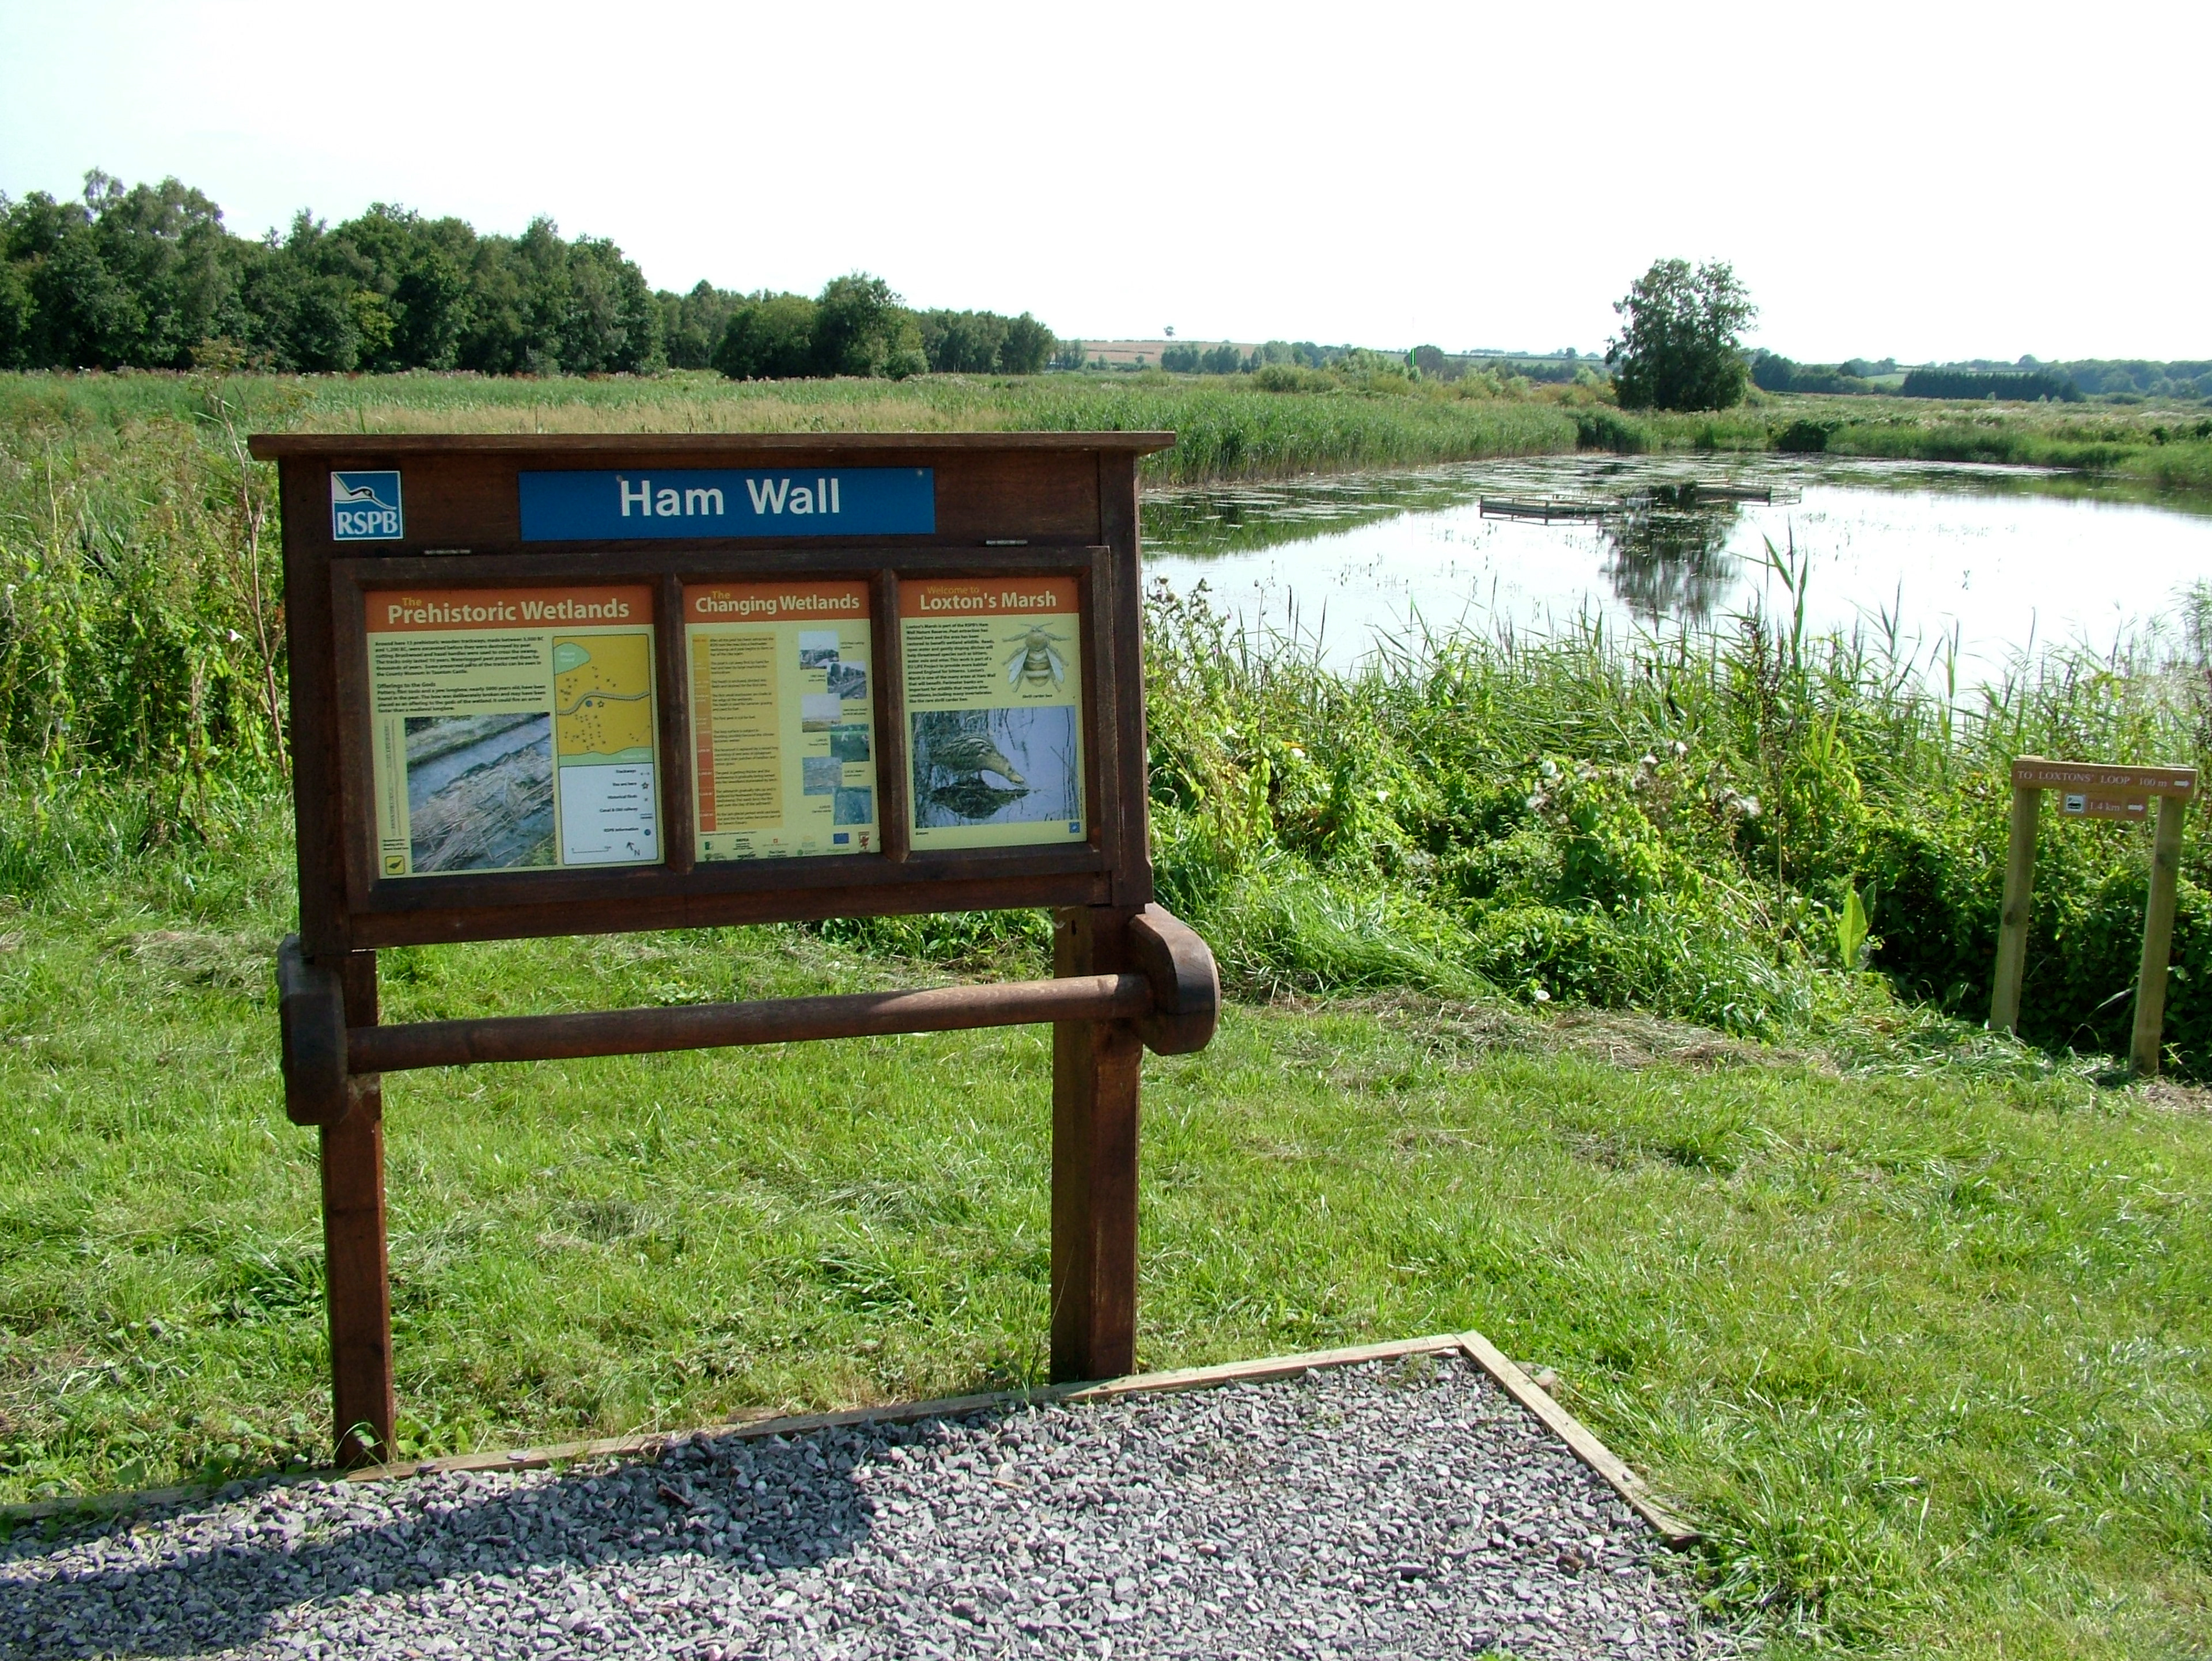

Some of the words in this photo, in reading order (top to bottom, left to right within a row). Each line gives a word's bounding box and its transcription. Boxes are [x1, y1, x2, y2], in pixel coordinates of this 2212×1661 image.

[621, 479, 724, 517] Ham
[747, 478, 840, 515] Wall
[336, 510, 398, 535] RSPB
[713, 591, 731, 600] The
[927, 586, 968, 595] Welcome
[402, 597, 422, 606] The
[695, 596, 777, 616] Changing
[779, 593, 860, 610] Wetlands
[920, 592, 997, 610] Loxton's
[1002, 591, 1056, 609] Marsh
[388, 600, 517, 624] Prehistoric
[521, 598, 630, 621] Wetlands
[2018, 771, 2033, 780] TO
[2101, 775, 2131, 786] LOOP
[2139, 777, 2156, 787] 100
[2090, 801, 2103, 810] 1.4
[2105, 801, 2120, 812] km
